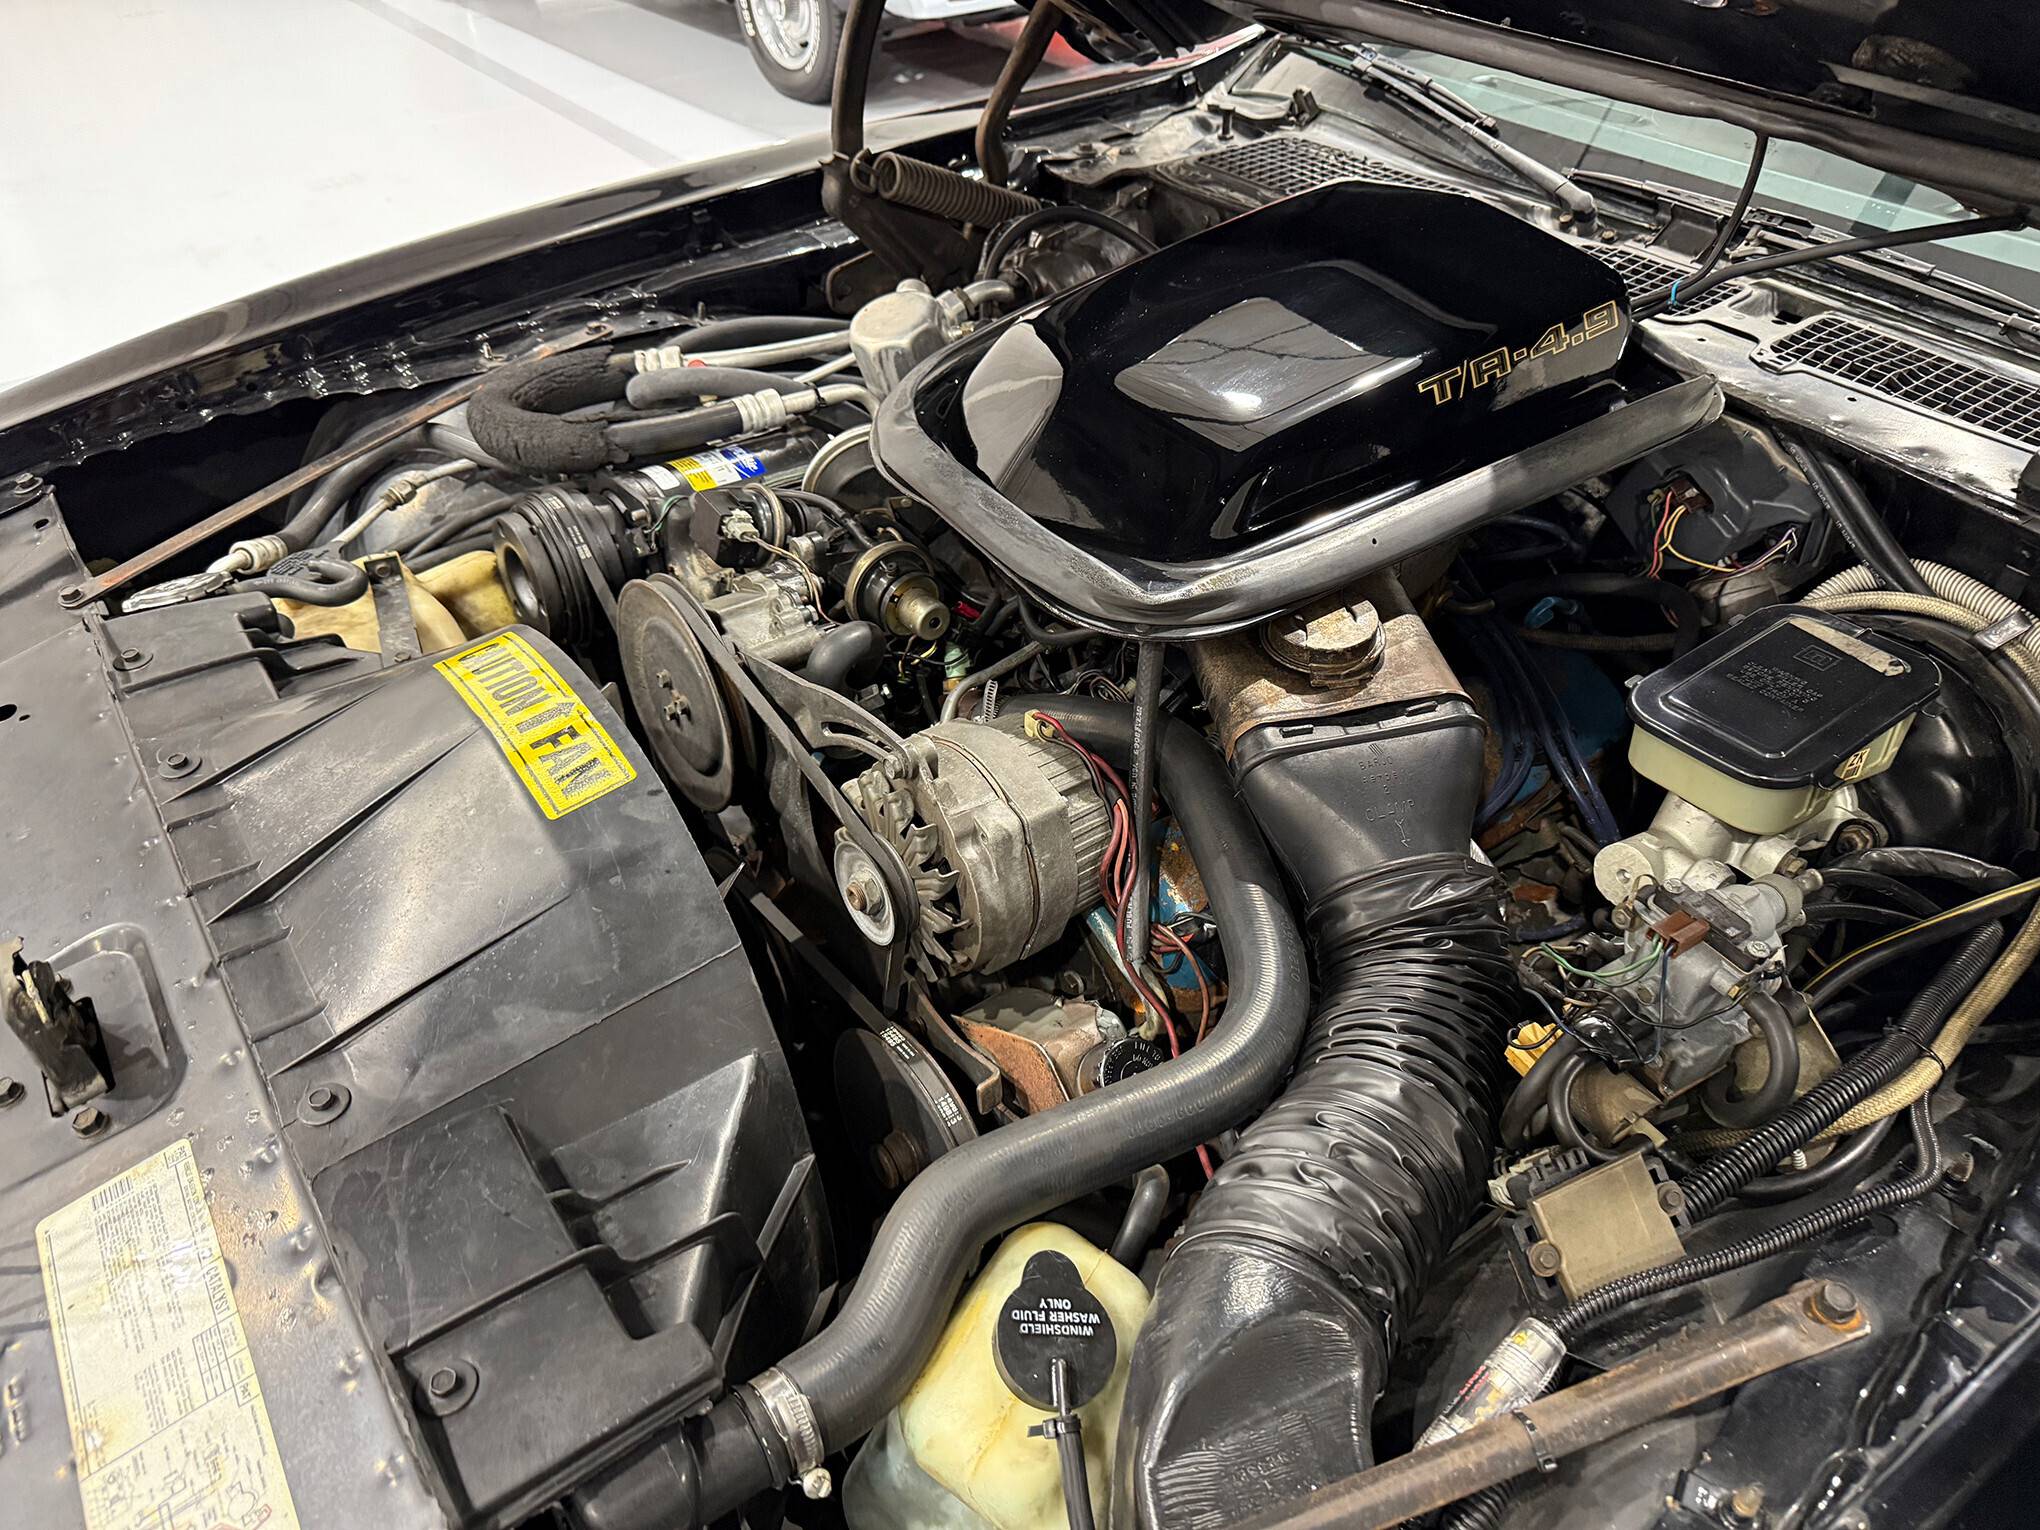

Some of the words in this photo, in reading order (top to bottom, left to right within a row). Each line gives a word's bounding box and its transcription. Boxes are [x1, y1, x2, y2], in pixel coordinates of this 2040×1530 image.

[530, 725, 612, 800] FAN
[206, 1266, 230, 1315] CATALYST
[1039, 1298, 1071, 1310] ONLY
[1012, 1310, 1045, 1321] FLUID
[1050, 1310, 1100, 1324] WASHER
[1020, 1324, 1093, 1336] WINDSHIELD
